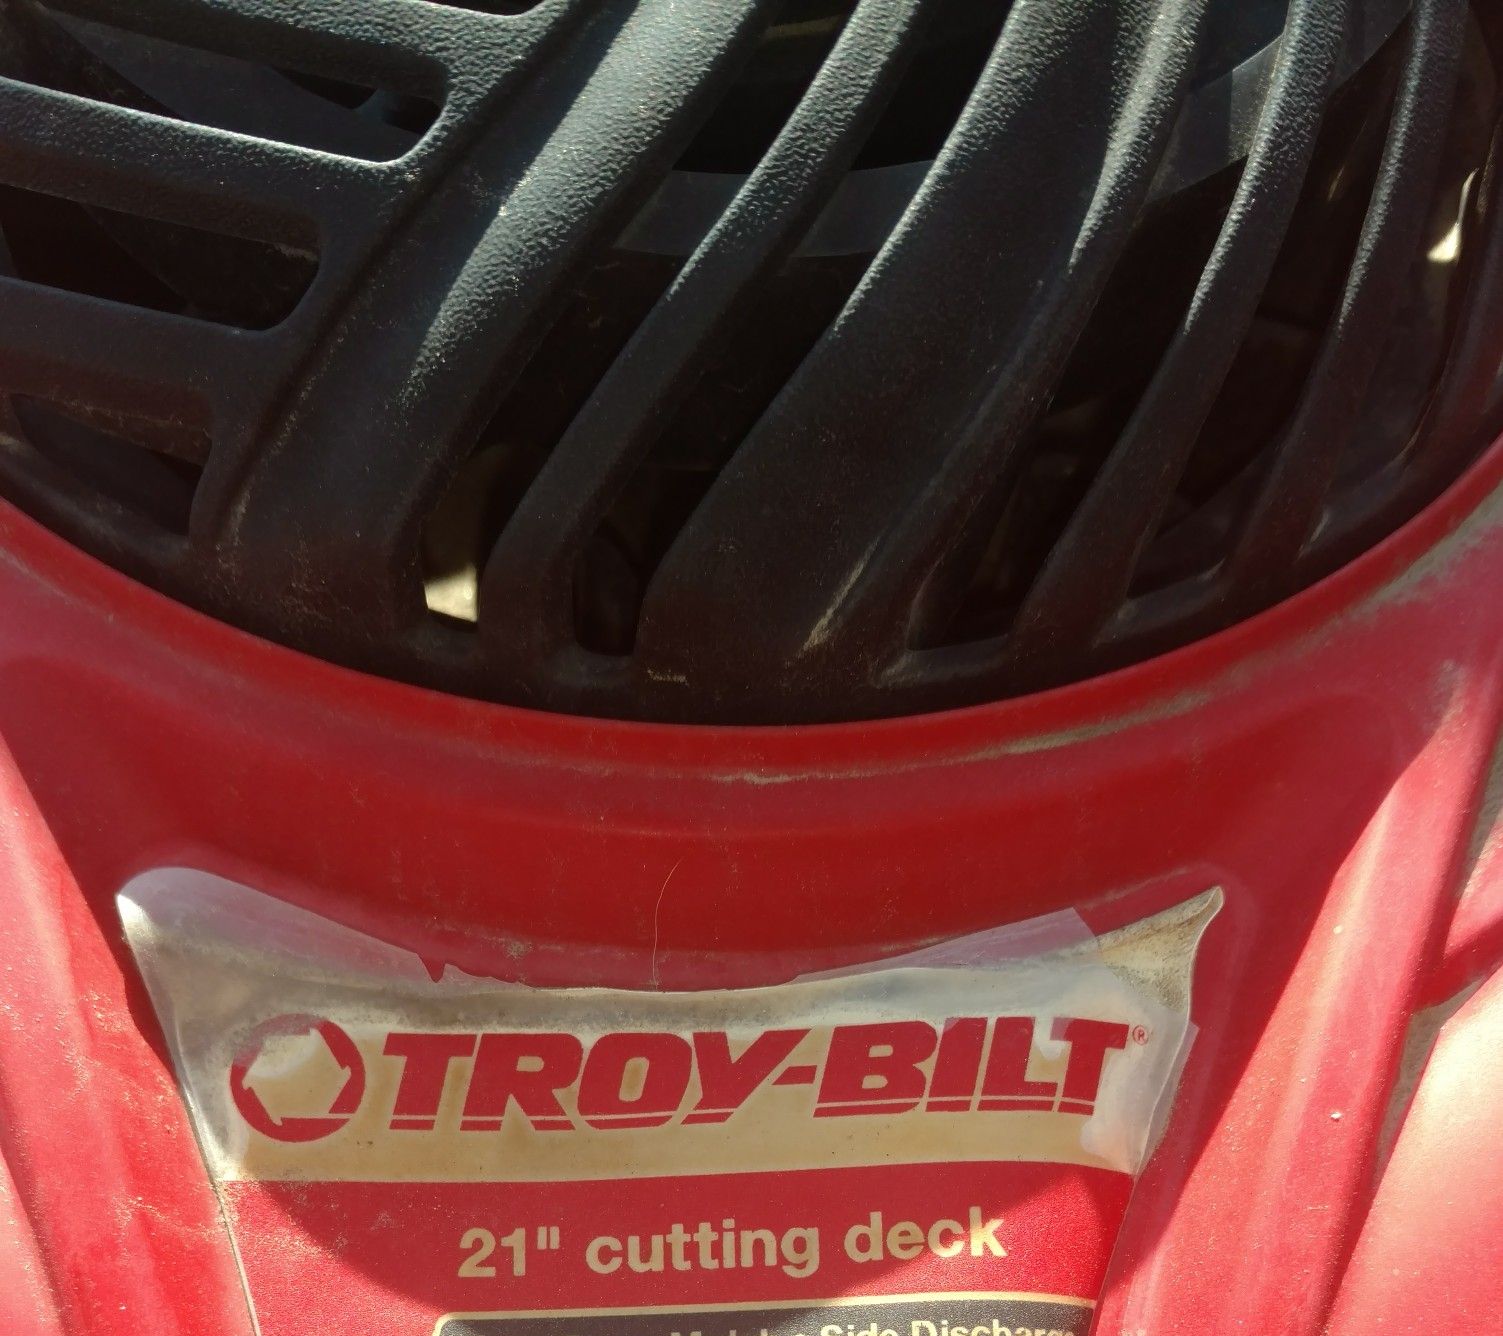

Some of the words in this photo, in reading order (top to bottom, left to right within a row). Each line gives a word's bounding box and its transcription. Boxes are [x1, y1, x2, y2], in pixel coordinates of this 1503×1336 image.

[382, 1016, 1129, 1131] TROY-BILT
[585, 1217, 820, 1279] cutting
[843, 1205, 1008, 1264] deck
